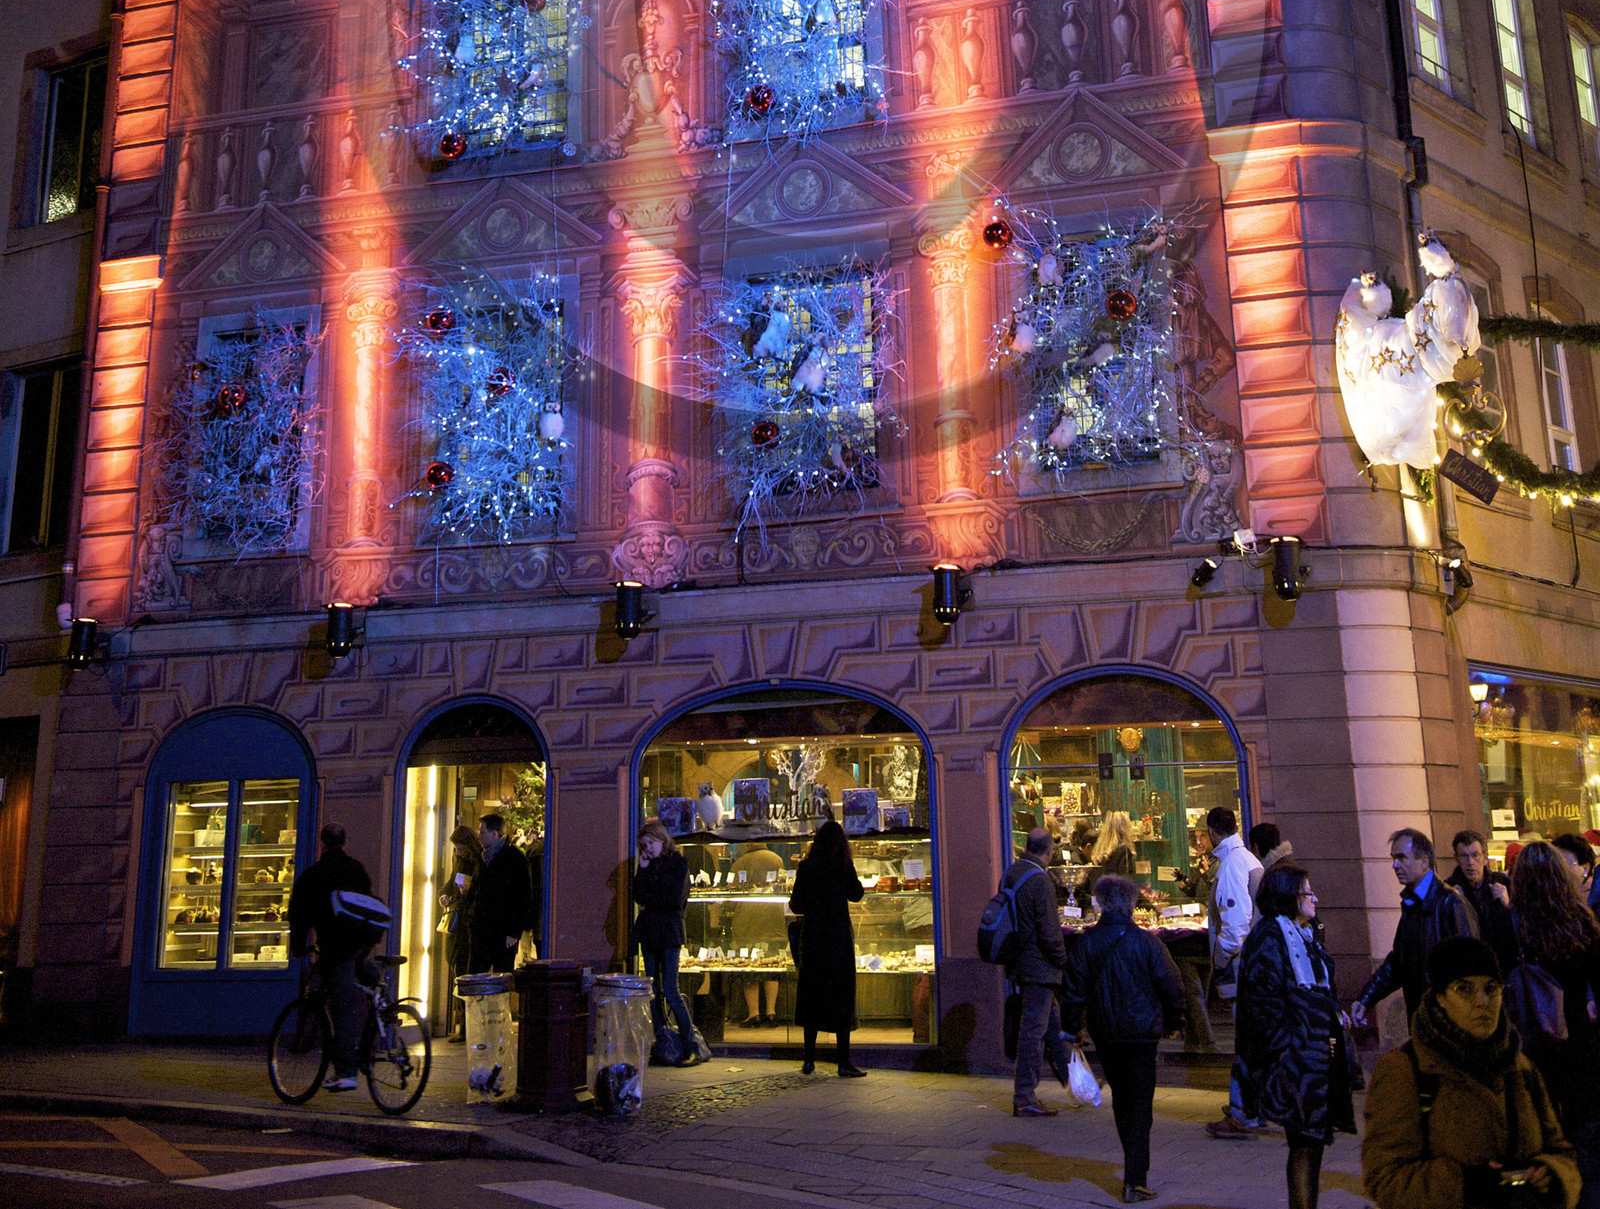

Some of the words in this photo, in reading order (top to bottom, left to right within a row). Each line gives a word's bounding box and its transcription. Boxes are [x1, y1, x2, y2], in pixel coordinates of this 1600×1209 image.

[1445, 456, 1492, 500] Christian
[742, 783, 826, 823] Christian
[1524, 796, 1581, 821] Christian
